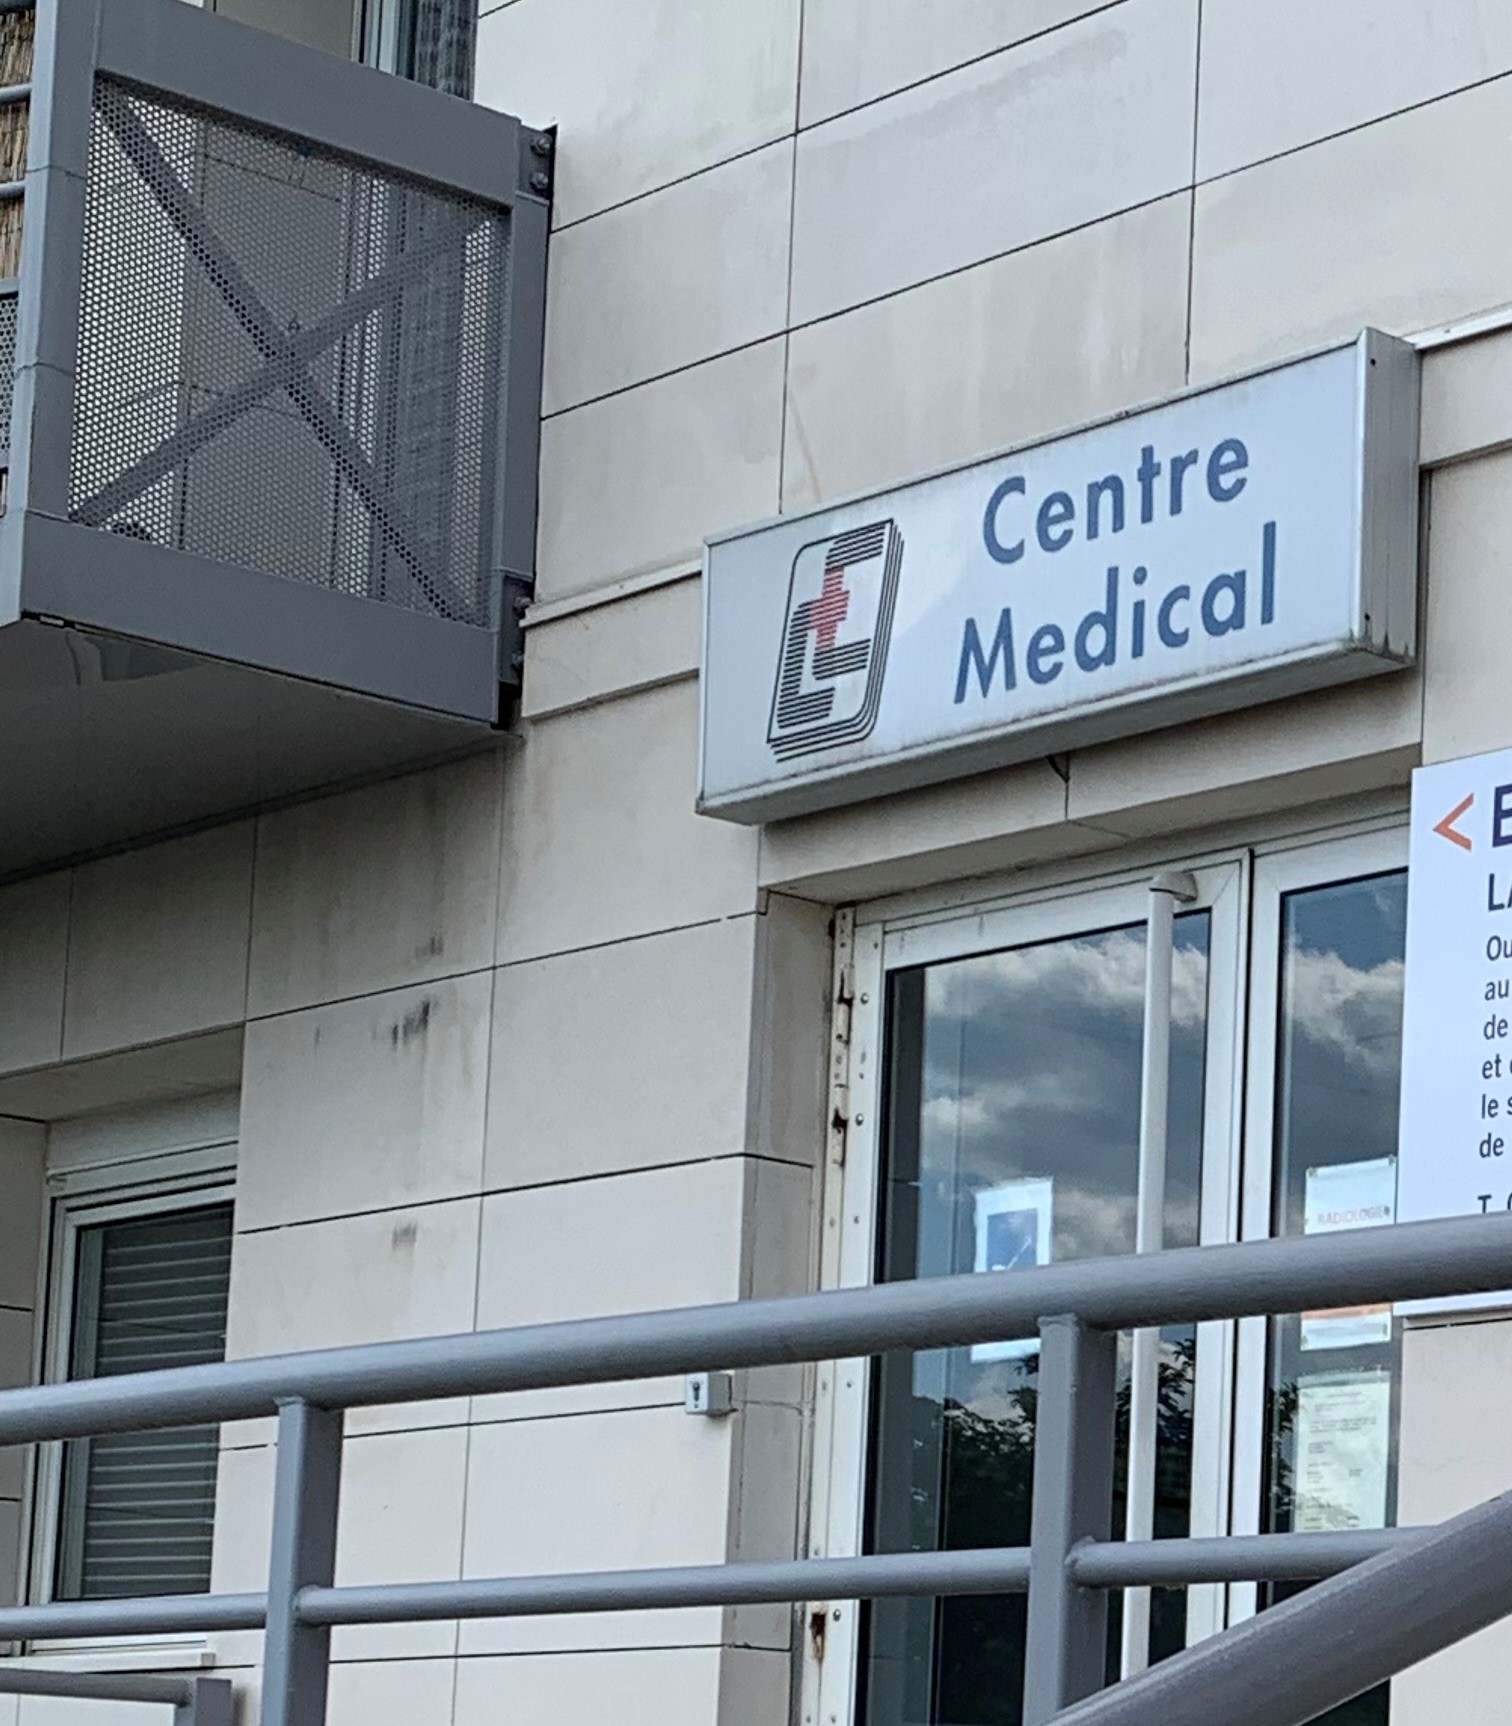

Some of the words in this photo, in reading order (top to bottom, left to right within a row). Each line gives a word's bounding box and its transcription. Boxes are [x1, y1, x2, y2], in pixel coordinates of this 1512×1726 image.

[983, 437, 1249, 565] Centre
[953, 520, 1277, 705] Medical
[1484, 979, 1510, 1001] au
[1483, 1013, 1509, 1040] de
[1481, 1053, 1502, 1080] et
[1481, 1093, 1499, 1119] le
[1478, 1132, 1505, 1158] de
